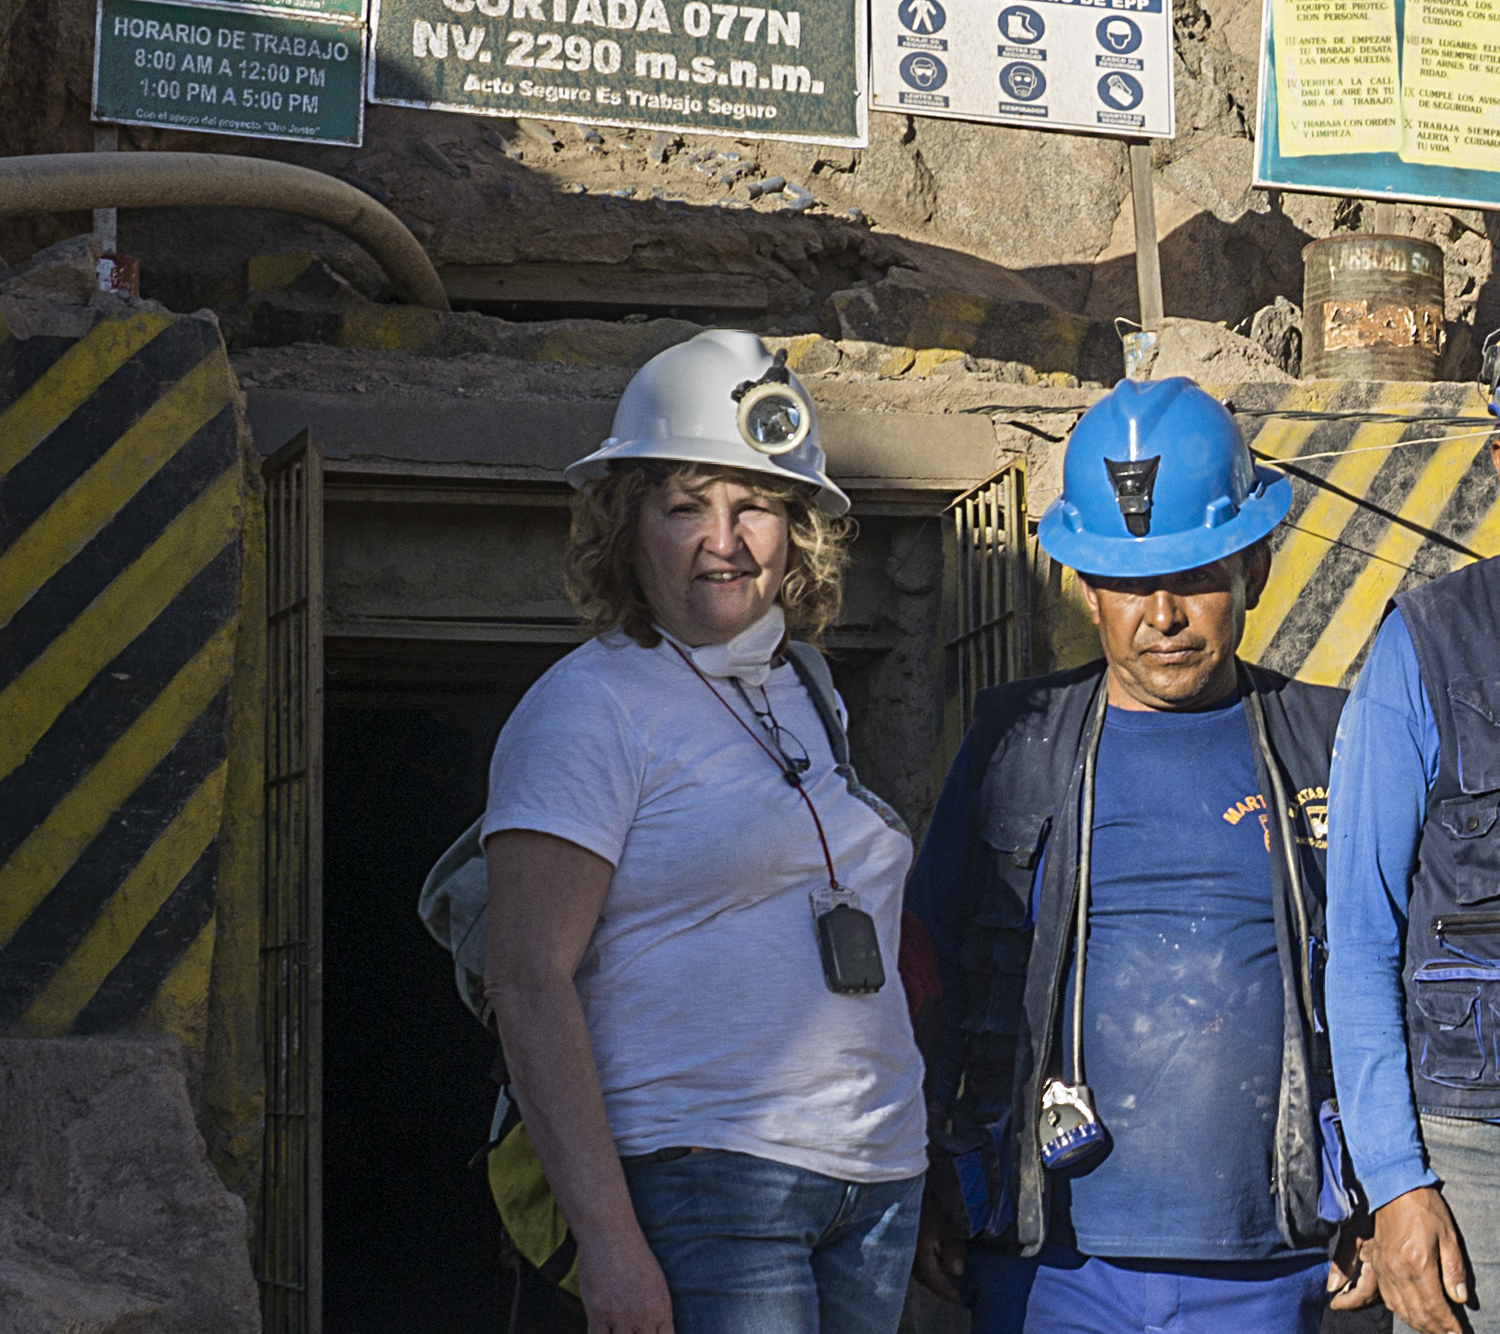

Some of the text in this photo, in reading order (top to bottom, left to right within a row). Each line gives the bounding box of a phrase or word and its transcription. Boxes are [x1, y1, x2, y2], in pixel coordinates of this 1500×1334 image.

[1422, 6, 1464, 17] PLOSIVOS
[1467, 11, 1485, 19] CON
[1476, 1, 1492, 10] LOS
[683, 1, 801, 48] 077N
[114, 17, 349, 61] HORARIO DE TRABAJO
[135, 49, 325, 87] 8:00 AM A 12:00 PM
[412, 19, 825, 95] NV. 2290 m.s.n.m.
[140, 79, 319, 114] 1:00 PM A 5:00 PM
[463, 74, 778, 121] Acto Seguro Es Trabajo Seguro
[136, 108, 156, 119] Con
[169, 113, 199, 125] apoyo
[219, 119, 261, 132] proyecto
[1303, 119, 1341, 128] TRABAJA
[1343, 118, 1363, 127] CON
[1365, 117, 1396, 126] ORDEN
[1417, 120, 1460, 132] TRABAJA
[1417, 132, 1449, 142] ALERTA
[1417, 142, 1428, 150] TU
